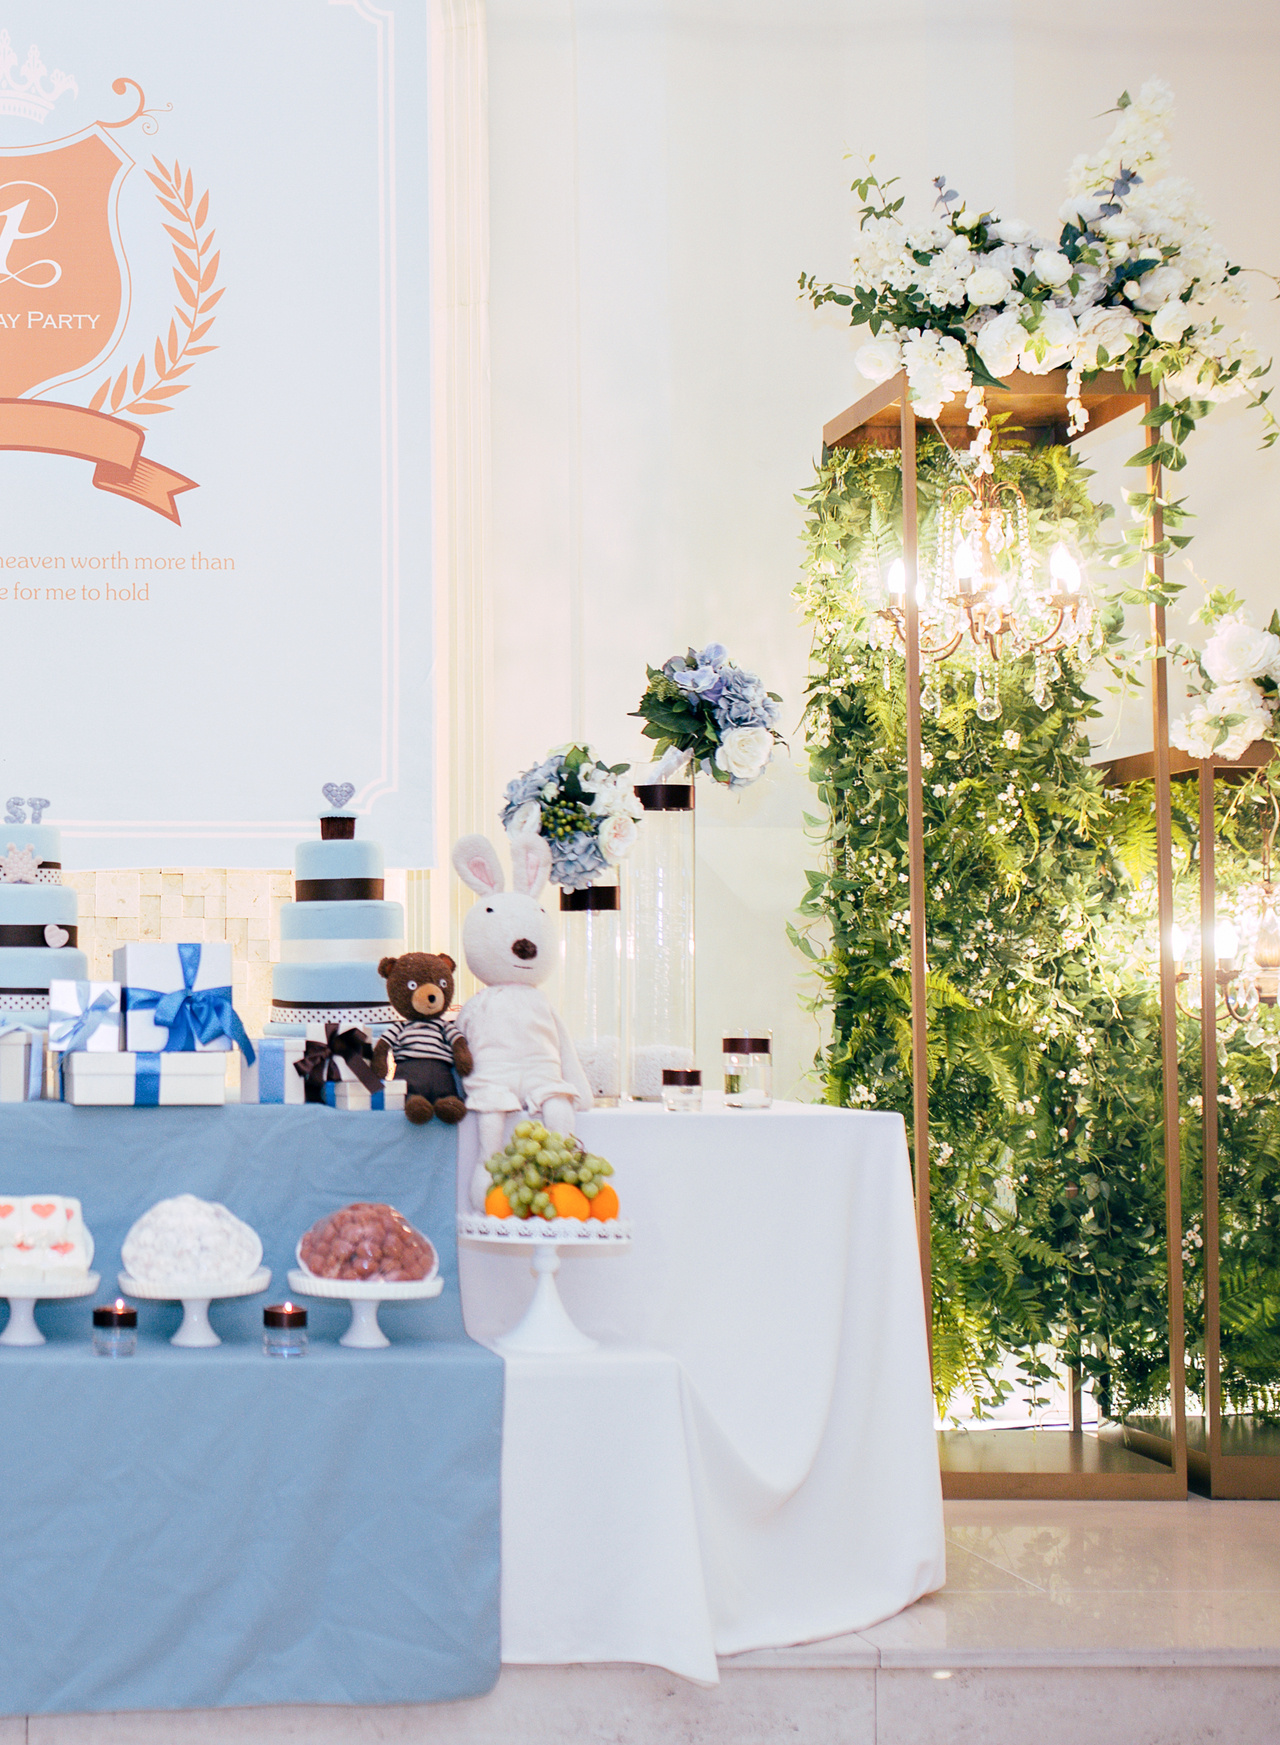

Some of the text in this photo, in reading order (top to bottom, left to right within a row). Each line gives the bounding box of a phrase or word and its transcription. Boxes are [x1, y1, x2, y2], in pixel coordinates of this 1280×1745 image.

[27, 311, 101, 330] PARTY
[70, 550, 129, 570] worth
[133, 556, 187, 571] more
[190, 552, 236, 571] than
[13, 582, 42, 601] for
[45, 587, 77, 601] me
[81, 584, 101, 601] to
[105, 582, 151, 602] hold
